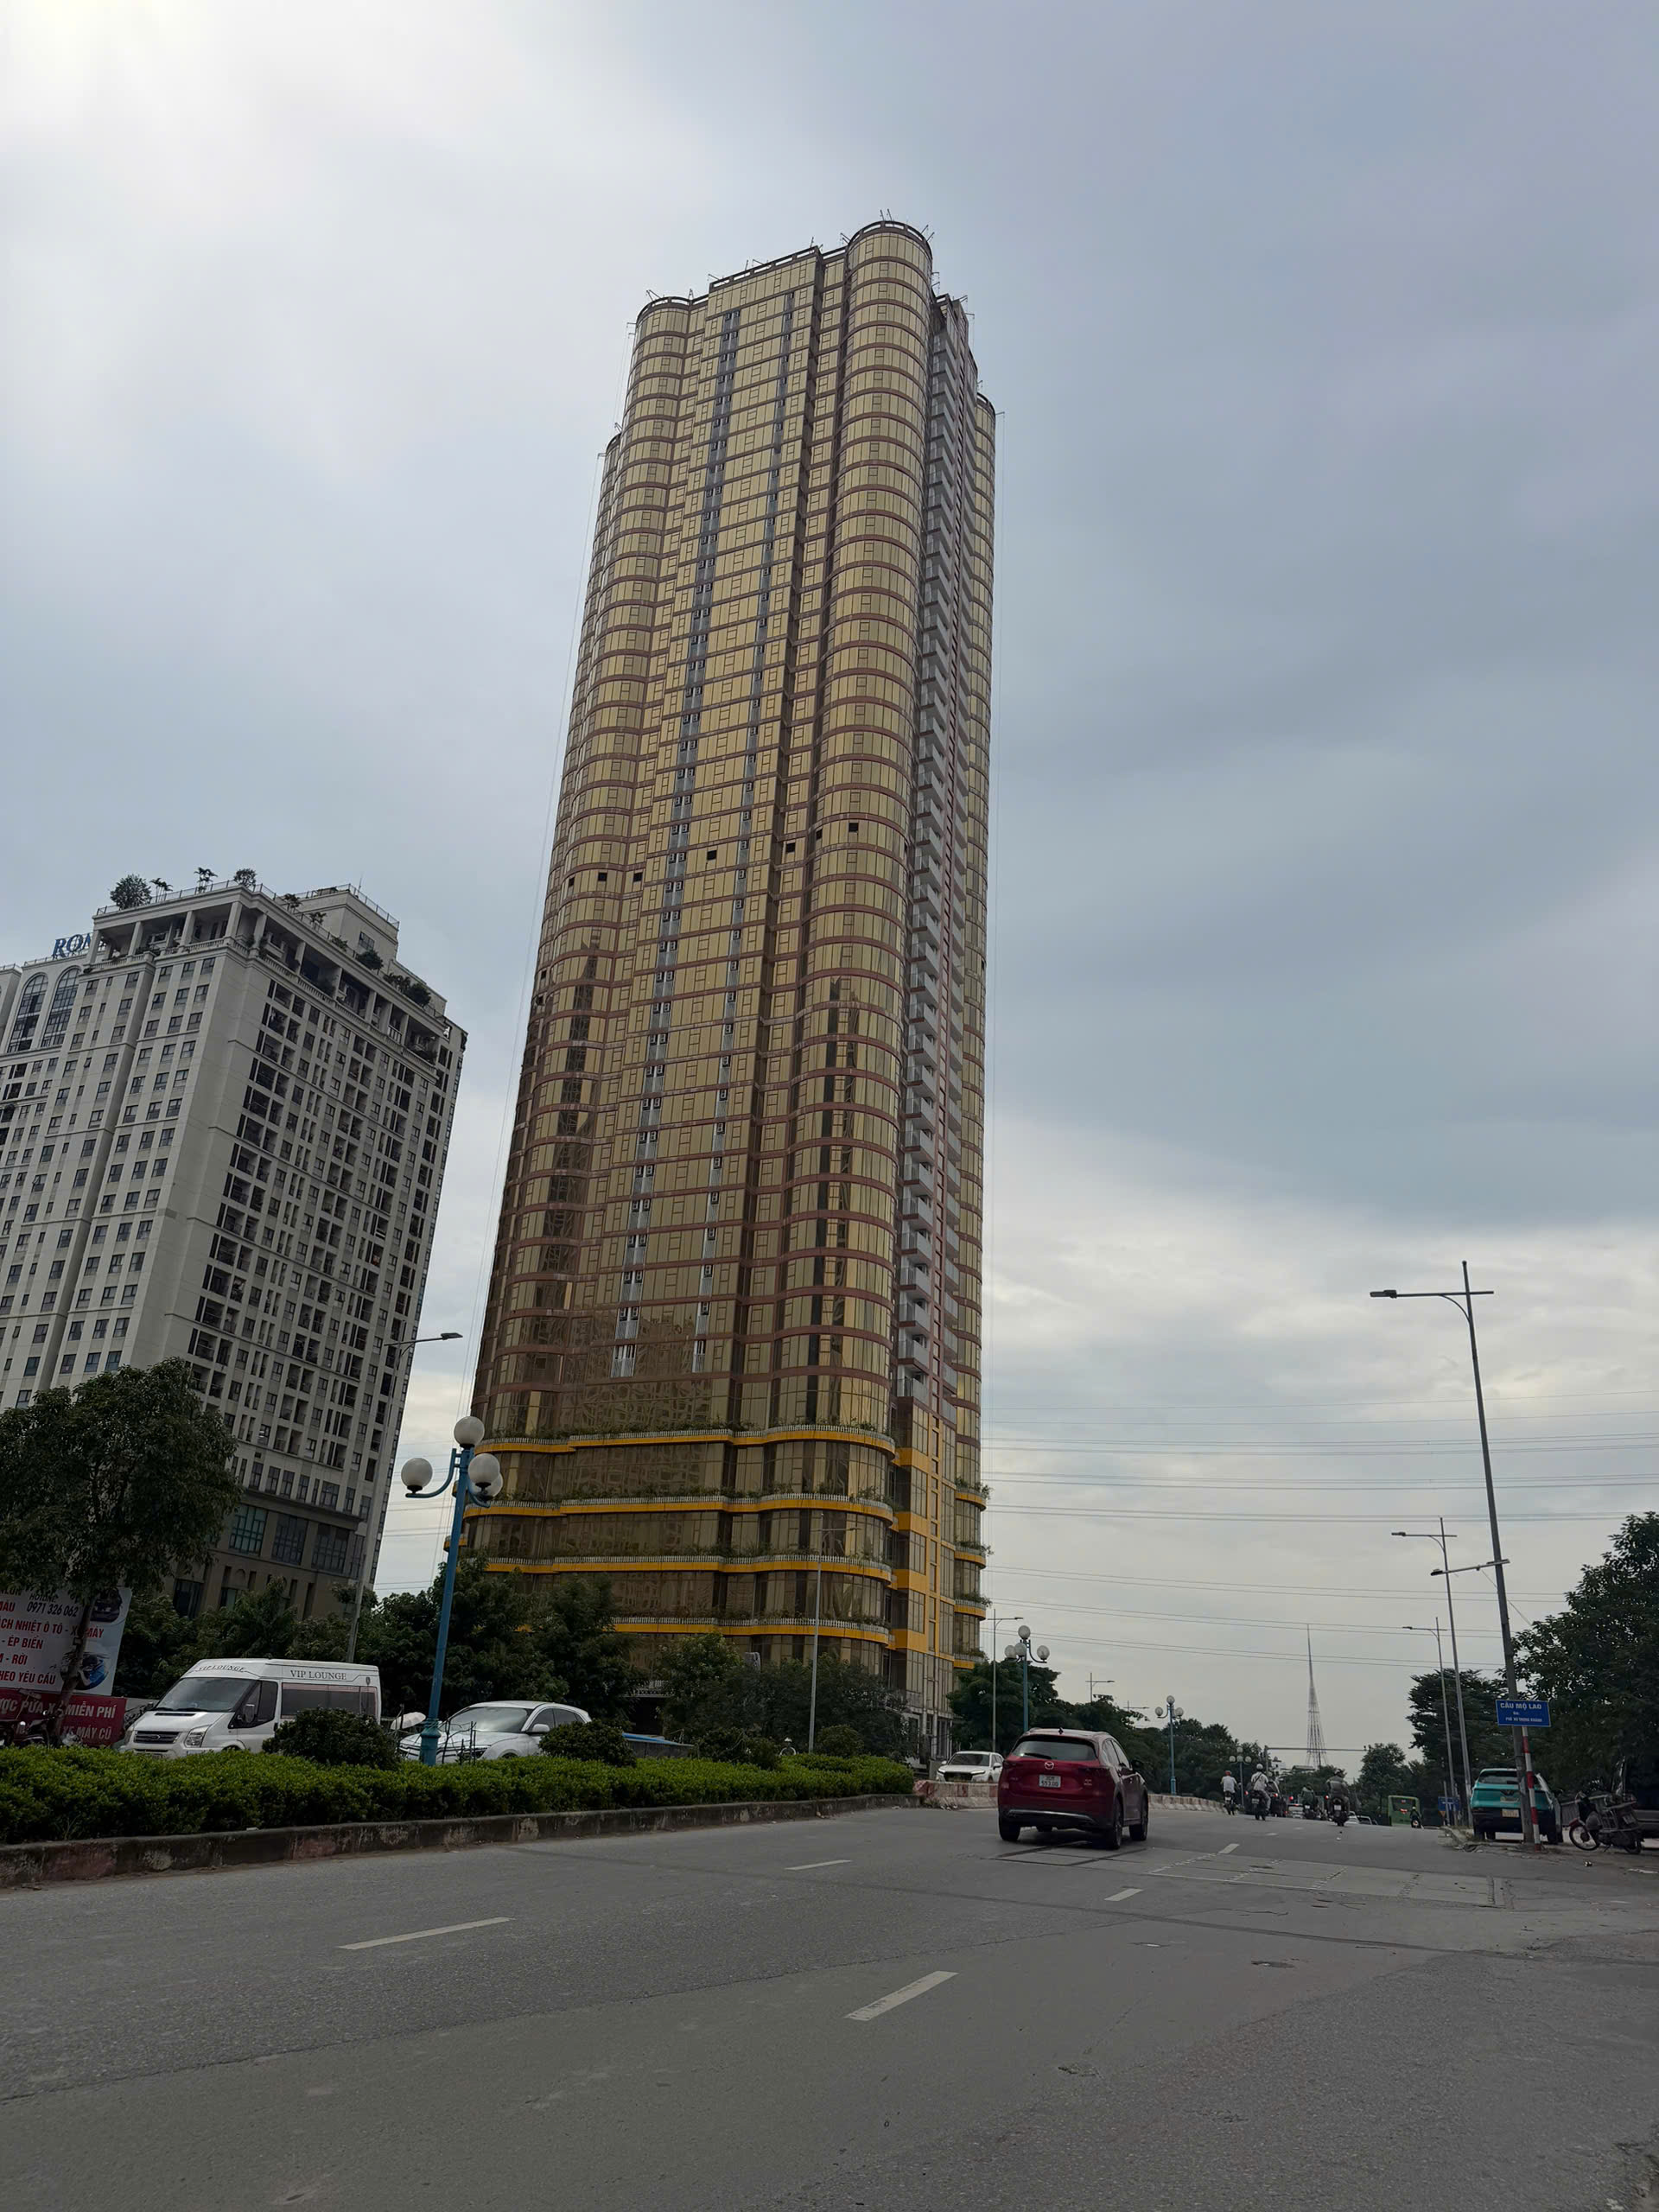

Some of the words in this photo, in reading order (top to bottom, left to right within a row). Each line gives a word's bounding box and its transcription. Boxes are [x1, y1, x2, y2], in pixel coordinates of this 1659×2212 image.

[27, 1601, 47, 1614] 0971
[48, 1604, 63, 1616] 326
[63, 1605, 79, 1618] 062
[0, 1618, 14, 1630] CH
[15, 1620, 42, 1635] NHIỆT
[43, 1621, 50, 1632] Ô
[52, 1622, 63, 1635] TÔ
[8, 1635, 20, 1647] ÉP
[18, 1670, 35, 1684] YÊU
[289, 1669, 307, 1678] VIP
[308, 1671, 346, 1681] LOUNGE
[97, 1705, 118, 1719] PHÍ
